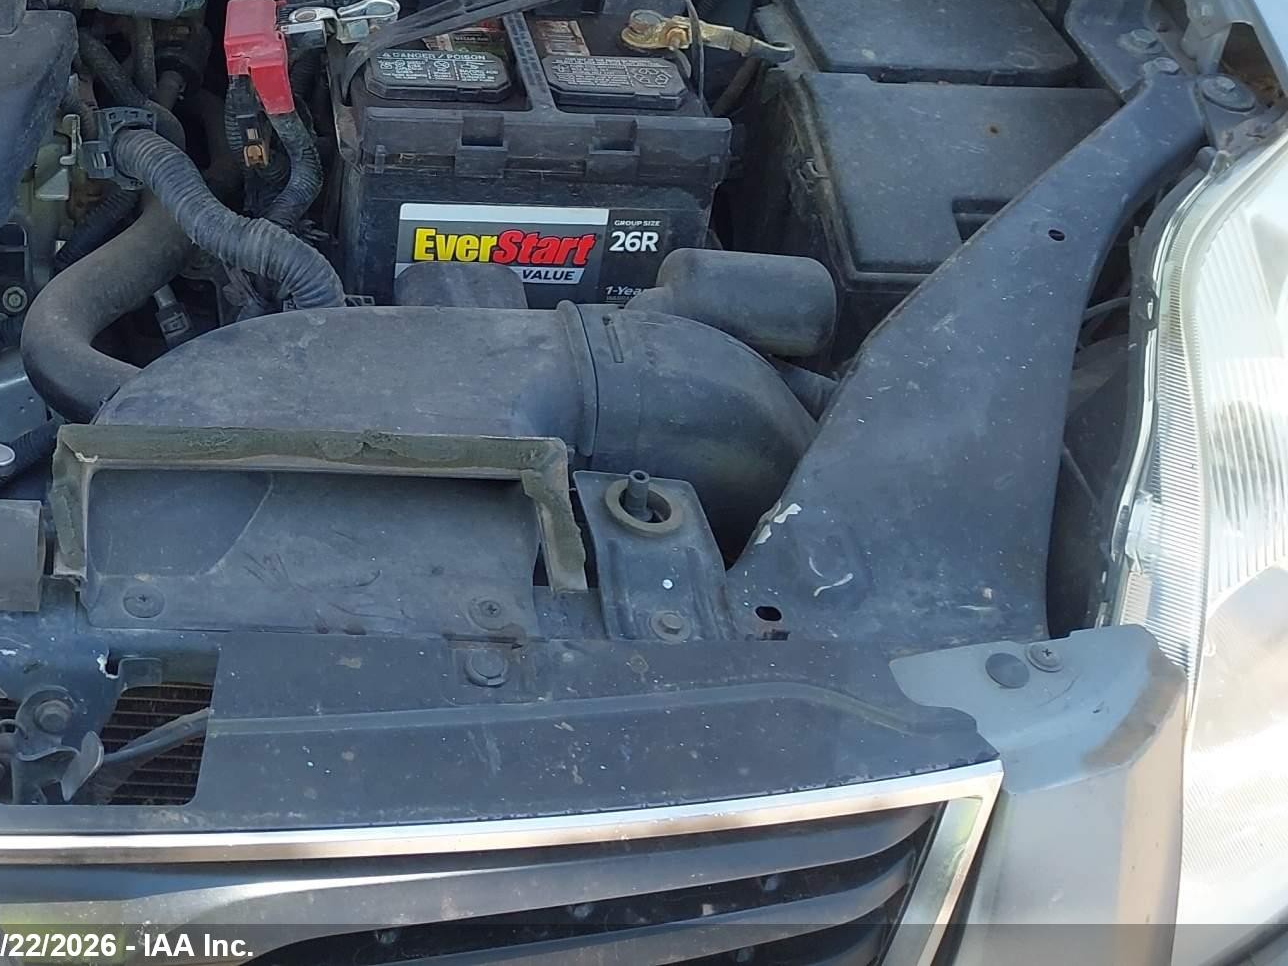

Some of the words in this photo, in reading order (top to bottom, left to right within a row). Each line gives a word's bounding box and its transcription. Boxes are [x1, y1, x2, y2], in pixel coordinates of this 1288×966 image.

[392, 52, 436, 60] DANGER
[446, 53, 486, 61] POISON
[412, 227, 597, 267] EverStart
[608, 230, 659, 253] 26R
[522, 269, 576, 282] VALUE
